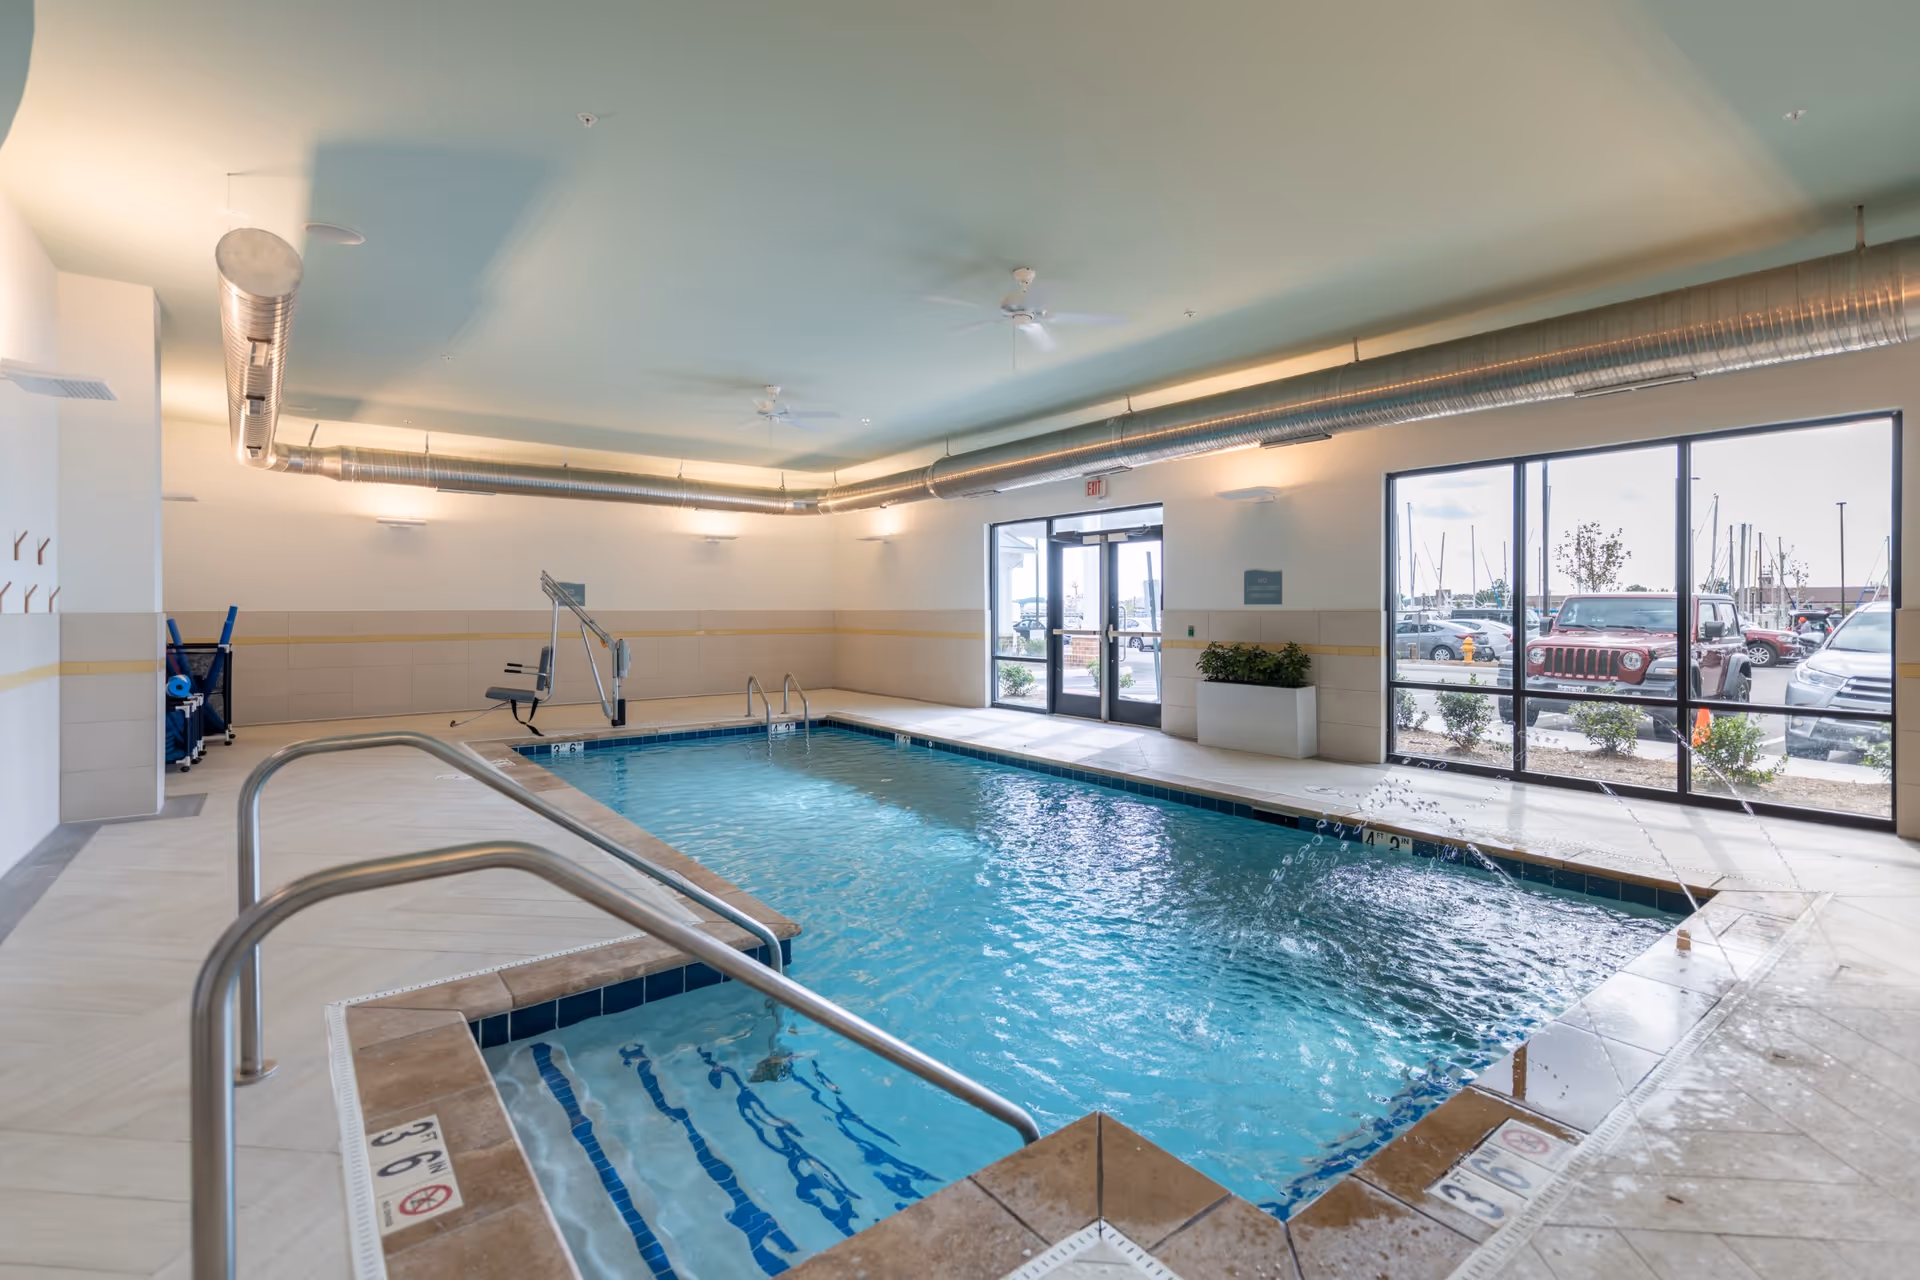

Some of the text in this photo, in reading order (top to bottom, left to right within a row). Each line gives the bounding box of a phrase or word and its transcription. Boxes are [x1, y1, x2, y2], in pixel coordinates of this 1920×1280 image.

[1087, 480, 1101, 496] EXIT
[569, 743, 576, 752] 6
[1365, 831, 1376, 846] 4
[1401, 837, 1410, 845] IN
[371, 1122, 434, 1147] 3
[420, 1131, 438, 1144] FT
[377, 1151, 442, 1177] 6
[1450, 1171, 1471, 1187] FT
[1470, 1158, 1531, 1189] 6
[1440, 1184, 1504, 1219] 3
